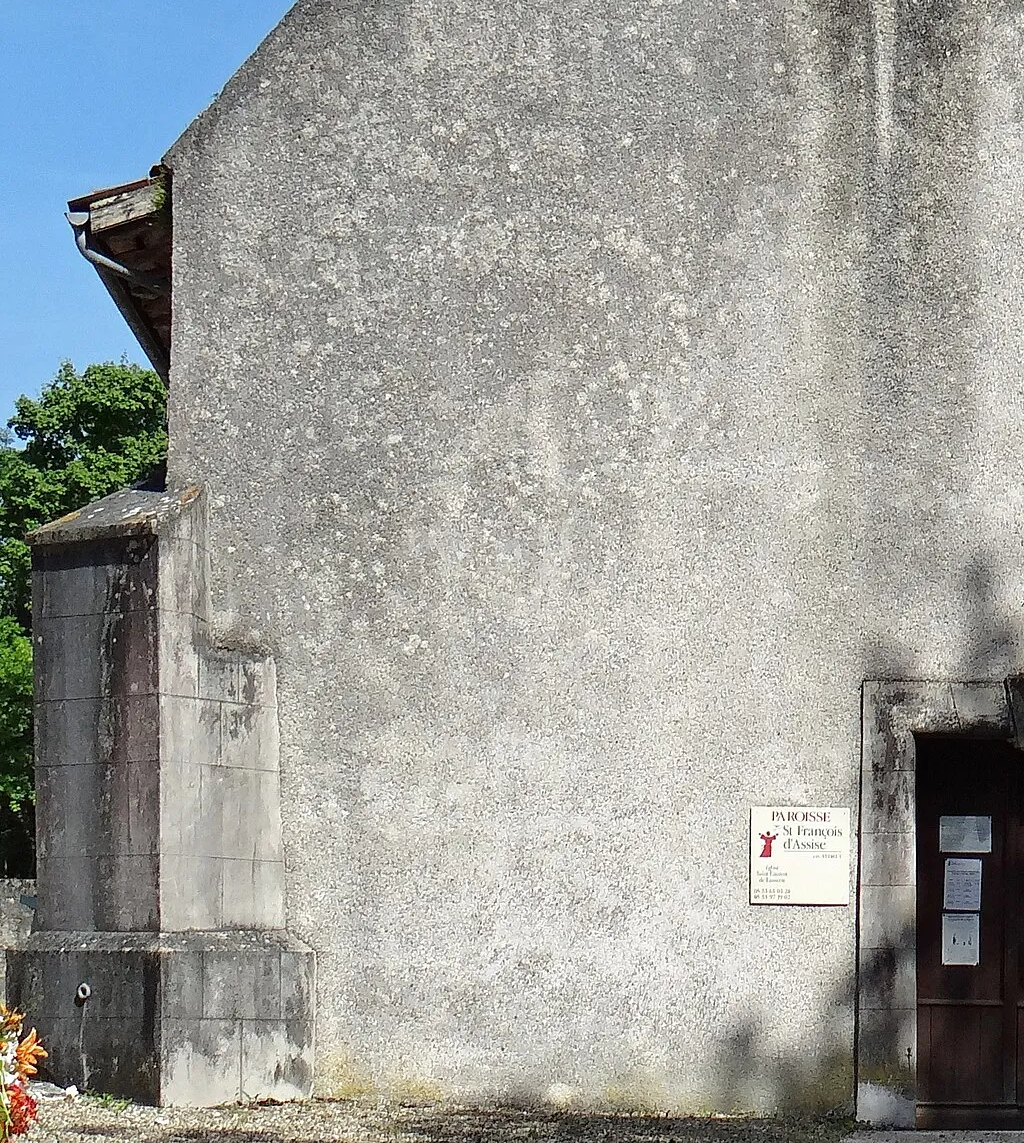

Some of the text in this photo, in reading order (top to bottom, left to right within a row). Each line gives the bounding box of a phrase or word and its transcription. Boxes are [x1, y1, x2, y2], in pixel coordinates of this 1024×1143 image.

[772, 811, 831, 822] PAROISSE
[782, 825, 843, 839] St François
[783, 838, 828, 850] d'Assise
